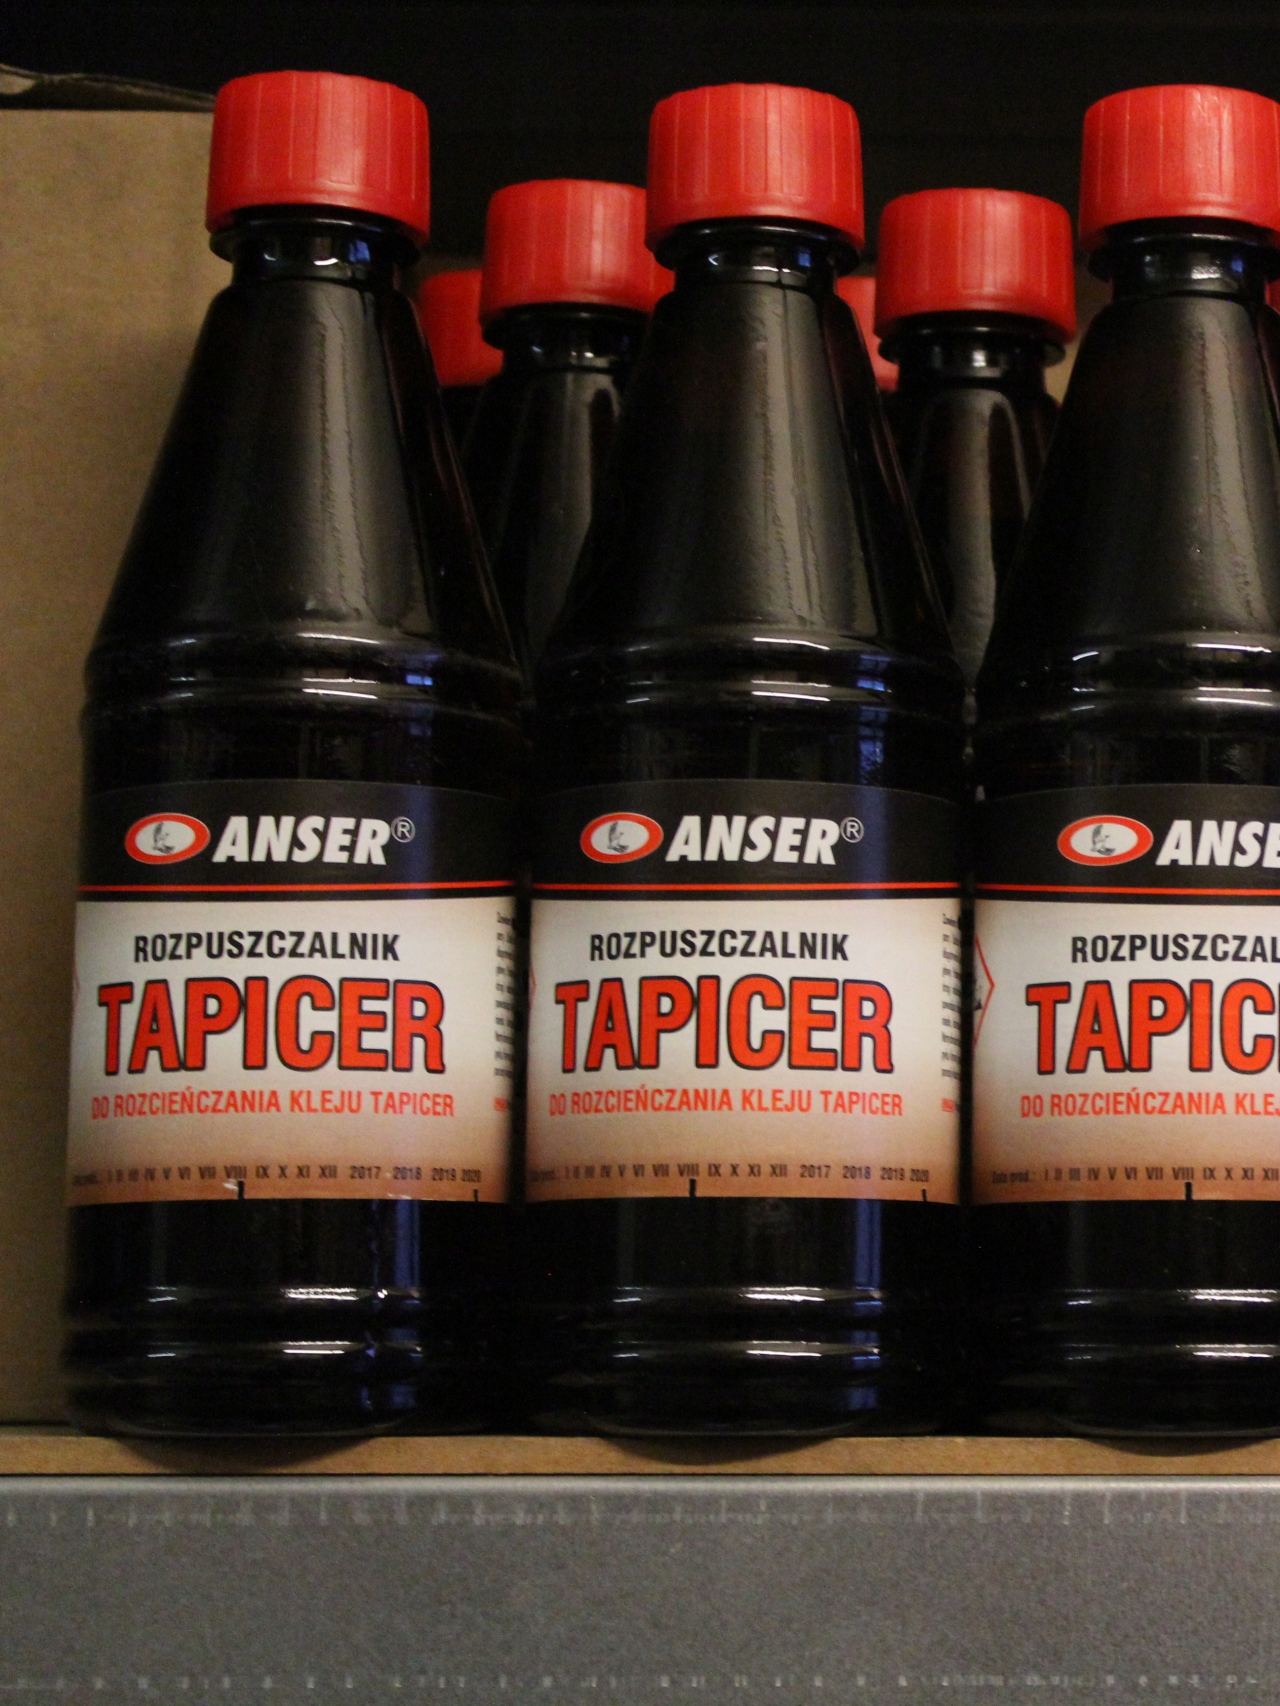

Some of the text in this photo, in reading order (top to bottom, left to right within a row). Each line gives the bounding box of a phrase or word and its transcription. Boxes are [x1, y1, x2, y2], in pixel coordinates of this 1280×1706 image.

[134, 931, 400, 962] ROZPUSZCZALNIK
[590, 930, 848, 961] ROZPUSZCZALNIK
[98, 975, 445, 1075] TAPICER
[555, 974, 894, 1073] TAPICER
[92, 1086, 454, 1119] DO ROZCIEŃCZANIA KLEJU TAPICER
[549, 1084, 903, 1116] DO ROZCIEŃCZANIA KLEJU TAPICER
[1020, 1094, 1043, 1118] DO
[1051, 1087, 1226, 1116] ROZCIEŃCZANIA
[163, 1167, 171, 1181] V
[178, 1166, 191, 1181] VI
[199, 1166, 216, 1180] VII
[224, 1166, 246, 1179] VIII
[256, 1165, 269, 1179] IX
[278, 1165, 287, 1179] X
[296, 1165, 310, 1179] XI
[319, 1165, 337, 1179] XII
[350, 1165, 381, 1180] 2017
[393, 1165, 421, 1180] 2018
[432, 1167, 456, 1182] 2019
[618, 1165, 626, 1178] V
[633, 1164, 645, 1178] VI
[653, 1164, 669, 1178] VII
[677, 1164, 699, 1178] VIII
[708, 1164, 721, 1178] IX
[730, 1164, 739, 1178] X
[748, 1164, 761, 1178] XI
[770, 1164, 787, 1178] XII
[800, 1165, 831, 1179] 2017
[843, 1165, 871, 1180] 2018
[880, 1167, 905, 1181] 2019
[1088, 1167, 1100, 1181] IV
[1109, 1167, 1117, 1181] V
[1125, 1167, 1137, 1181] VI
[1146, 1167, 1163, 1181] VII
[1172, 1167, 1194, 1181] VIII
[1203, 1167, 1216, 1181] IX
[1225, 1167, 1233, 1181] X
[1242, 1167, 1255, 1181] XI
[1263, 1167, 1279, 1181] XII
